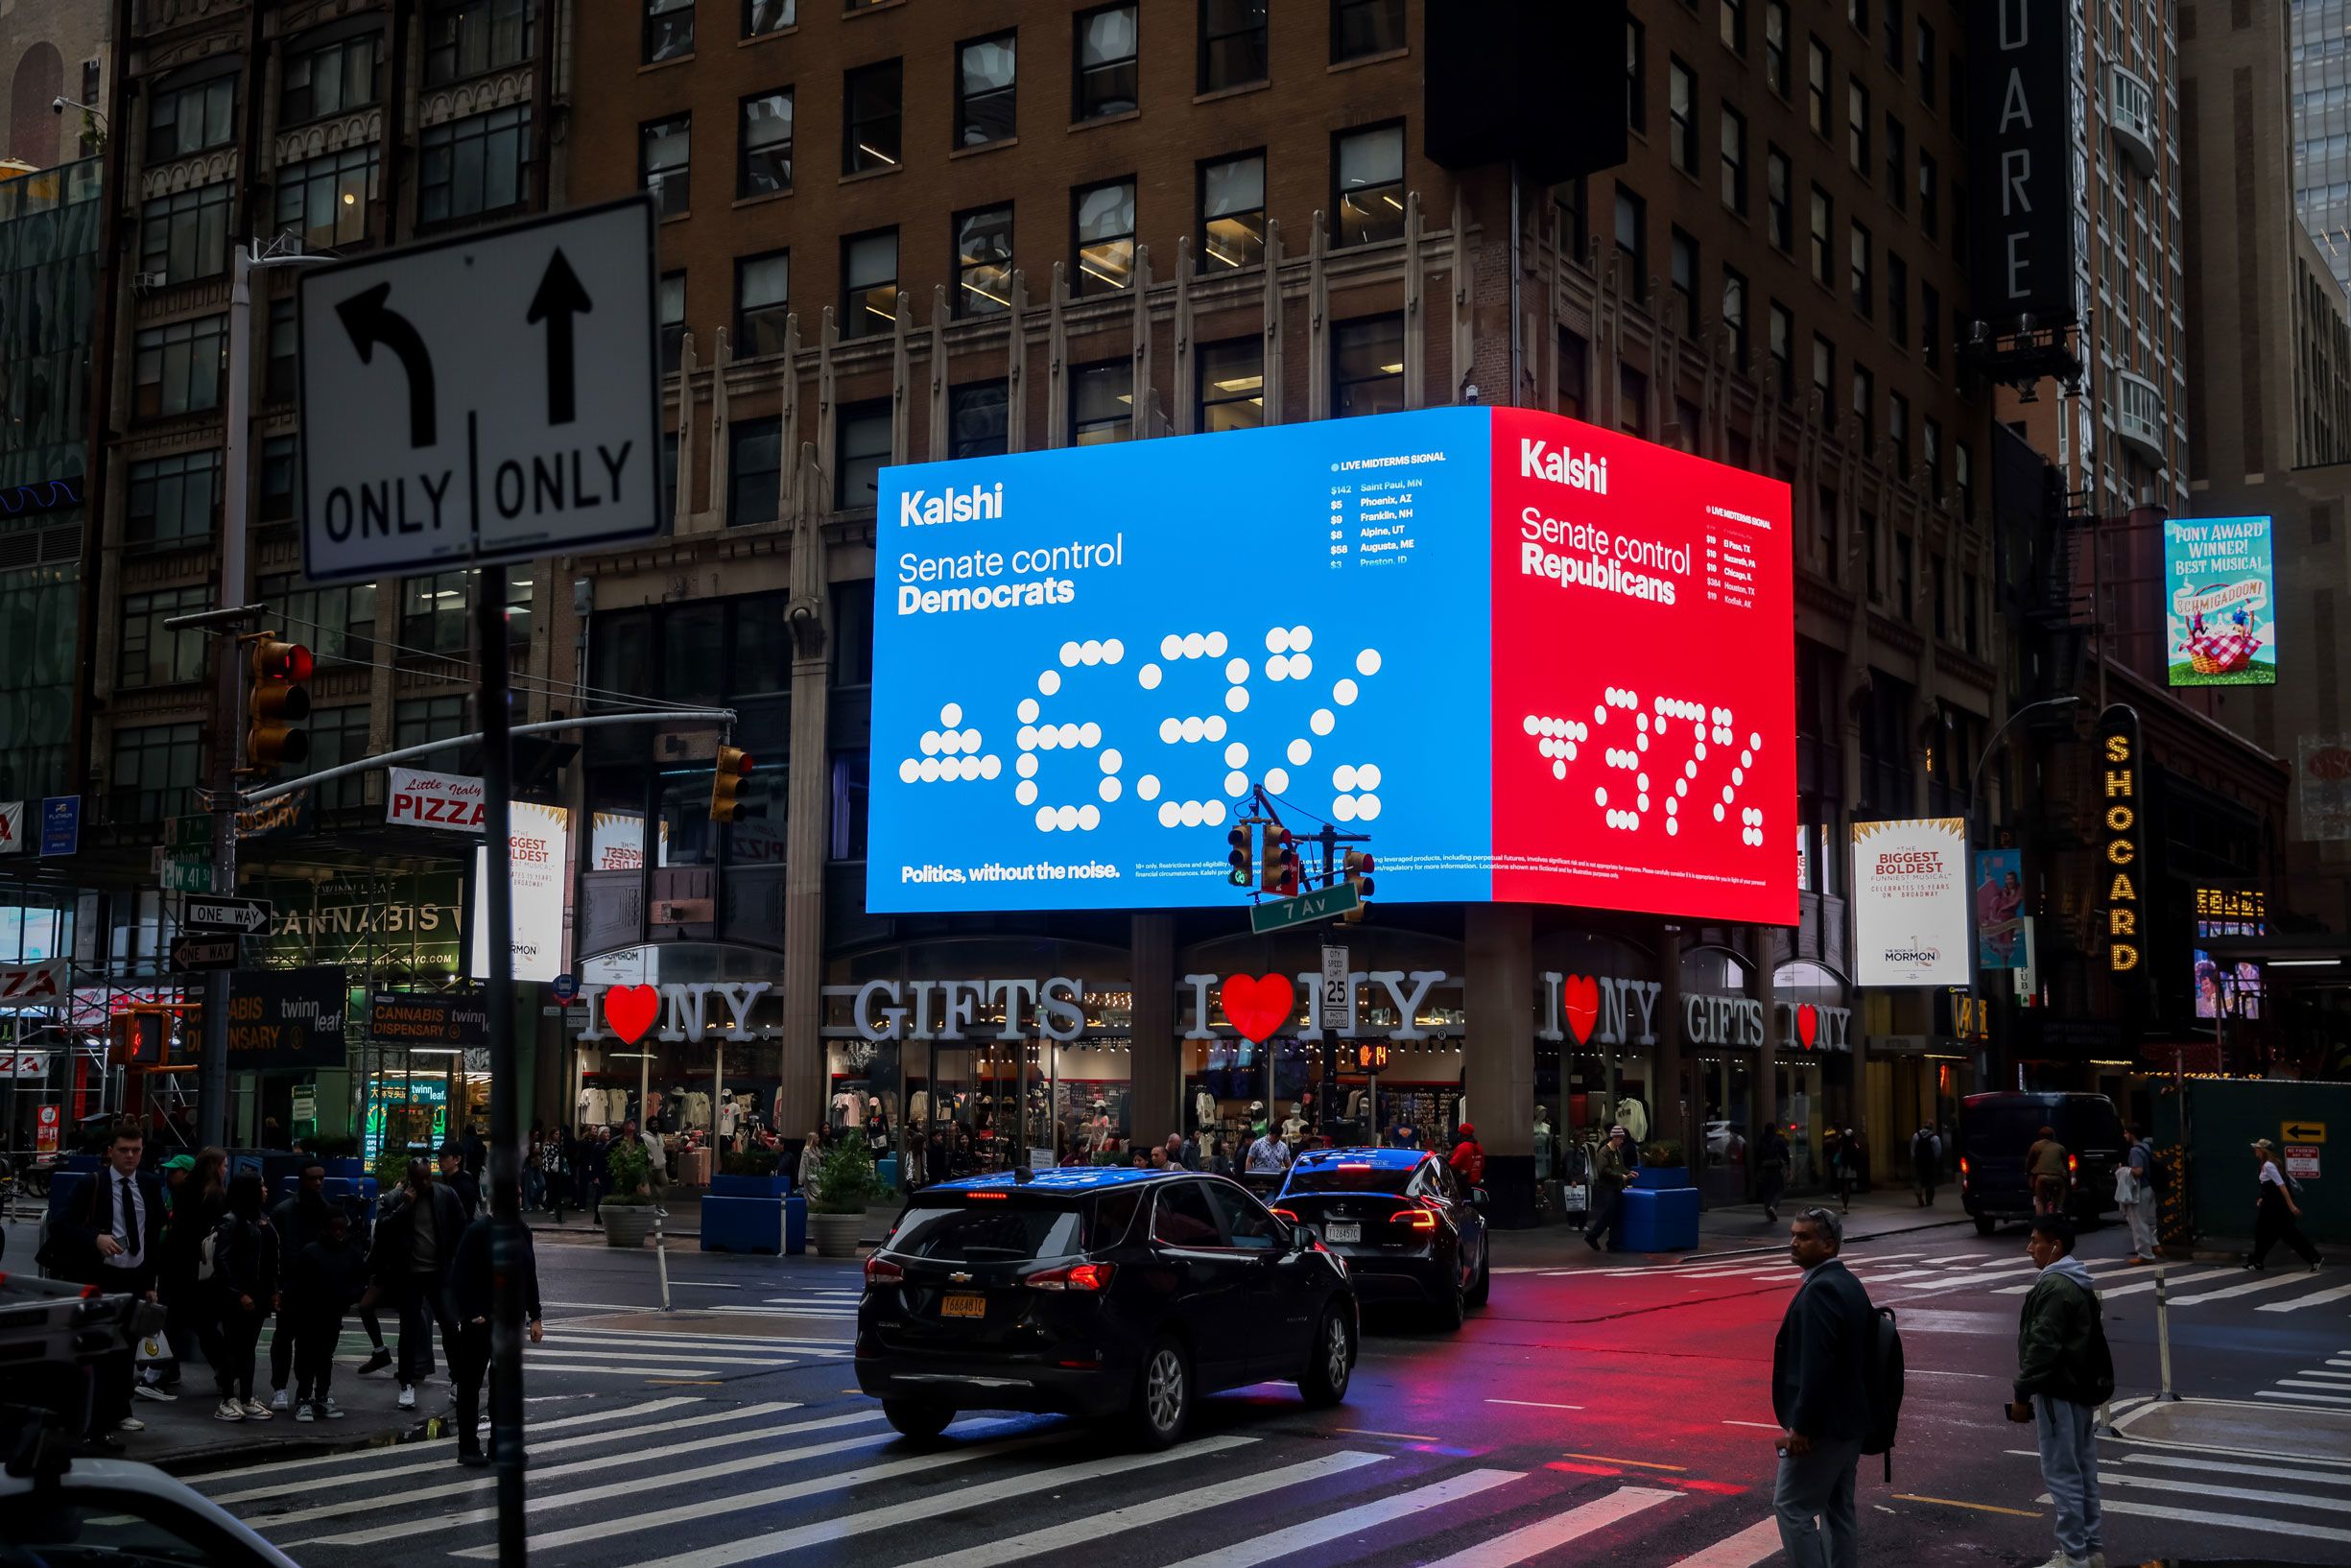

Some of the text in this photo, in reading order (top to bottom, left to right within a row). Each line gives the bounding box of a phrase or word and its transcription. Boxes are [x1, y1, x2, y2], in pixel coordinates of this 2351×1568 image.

[1341, 452, 1446, 471] LIVE MIDTERMS SIGNAL
[1521, 438, 1607, 495] Kalshi
[496, 440, 631, 519] ONLY
[1331, 479, 1423, 496] $142 Saint Paul, MN
[326, 470, 452, 542] ONLY
[900, 482, 1004, 527] Kalshi
[1330, 493, 1413, 511] $5 Phoenix, AZ
[1330, 509, 1413, 526] $9 Franklin, NH
[1711, 506, 1771, 530] LIVE MIDTERMS SIGNAL
[1330, 525, 1405, 540] $8 Alpine, UT
[1521, 507, 1691, 577] Senate control
[2211, 522, 2264, 540] AWARD
[898, 532, 1123, 583] Senate control
[1360, 542, 1399, 555] Augusta,
[1400, 539, 1414, 549] ME
[2188, 539, 2248, 559] WINNER!
[1397, 556, 1408, 564] ID
[2175, 557, 2265, 576] BEST MUSICAL
[1521, 542, 1675, 606] Republicans
[897, 577, 1075, 615] Democrats
[2177, 582, 2263, 614] SCHMIGADOON!
[1594, 686, 1763, 846] 37%
[405, 778, 483, 797] Little Italy
[393, 794, 487, 825] PIZZA
[510, 836, 546, 850] GGEST
[2104, 734, 2140, 972] SHOCARD
[511, 850, 549, 863] LDEST
[1384, 854, 1413, 863] leveraged
[1413, 854, 1442, 863] products,
[1442, 853, 1471, 862] including
[176, 866, 184, 886] W
[188, 867, 200, 888] 41
[901, 860, 1121, 884] Politics, without the noise.
[198, 907, 259, 923] ONE WAY
[1283, 898, 1325, 919] 7 Av
[180, 945, 230, 961] ONE WAY
[511, 944, 537, 955] RMON
[1885, 952, 1935, 962] MORMON
[1327, 980, 1345, 1003] 25
[281, 996, 320, 1019] twinn
[375, 1005, 445, 1022] CANNABIS
[451, 1009, 486, 1023] twinn
[577, 982, 772, 1043] I NY
[854, 977, 1084, 1041] GIFTS
[1184, 973, 1219, 1040] I
[1541, 971, 1662, 1045] I NY
[314, 1010, 343, 1033] leaf
[373, 1023, 445, 1036] DISPENSARY
[1687, 993, 1765, 1048] GIFTS
[1787, 1003, 1851, 1051] I NY
